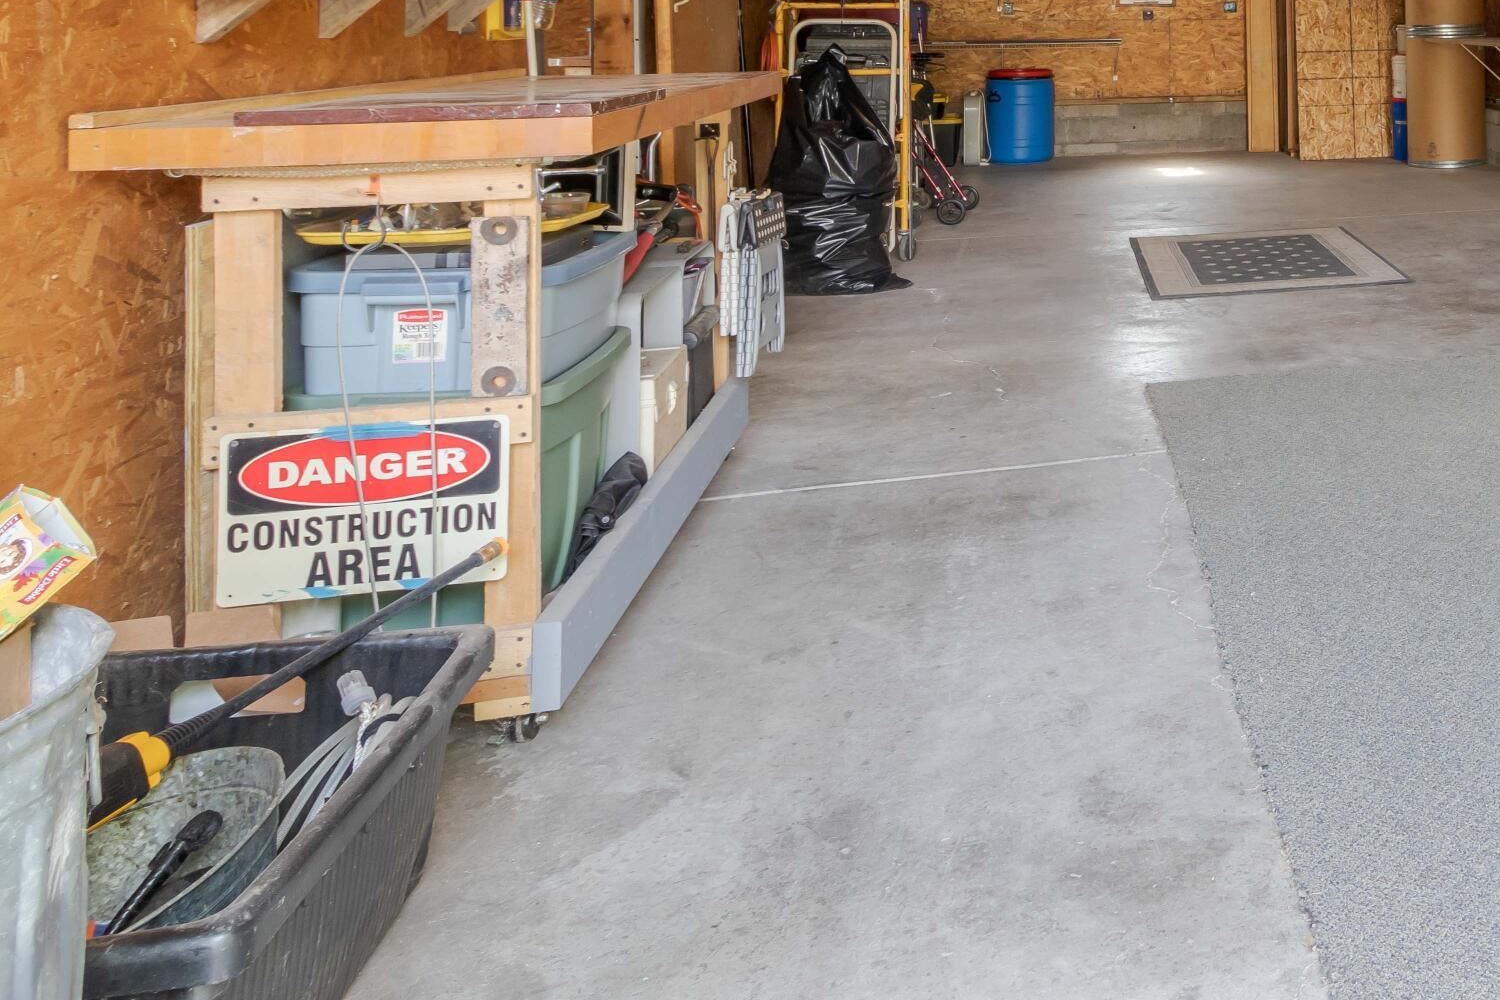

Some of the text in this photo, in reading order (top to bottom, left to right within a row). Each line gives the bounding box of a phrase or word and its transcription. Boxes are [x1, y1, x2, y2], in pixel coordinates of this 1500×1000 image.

[400, 323, 440, 333] Keepes
[267, 447, 468, 489] DANGER
[227, 501, 497, 553] CONSTRUCTION
[306, 543, 422, 587] AREA
